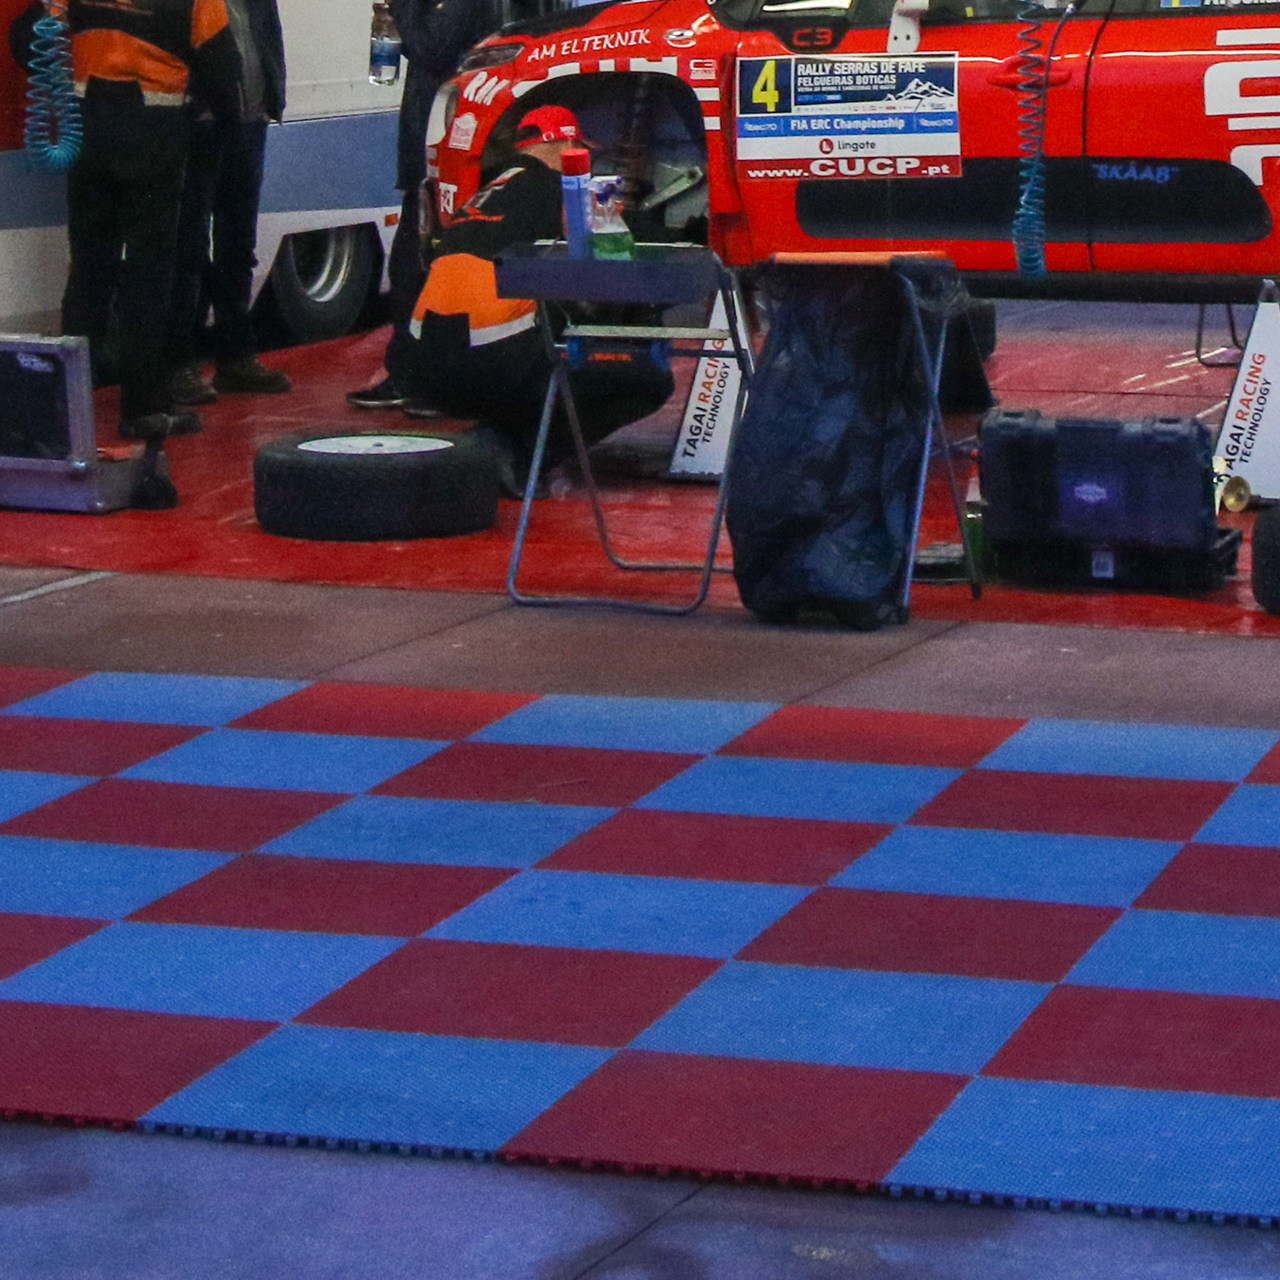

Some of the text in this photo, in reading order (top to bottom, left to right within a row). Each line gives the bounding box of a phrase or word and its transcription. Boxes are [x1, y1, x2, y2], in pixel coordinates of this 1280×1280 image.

[527, 28, 652, 62] AM ELTEKNIK
[792, 28, 833, 46] C3
[797, 60, 926, 76] RALLY SERRAS DE FAFE
[797, 74, 897, 86] FELGUEIRAS BOTICAS
[752, 59, 780, 113] 4
[790, 117, 906, 131] FIA ERC Championship
[747, 158, 950, 178] www.CUCP.pt
[701, 361, 731, 445] TECHNOLOGY
[1237, 352, 1267, 423] RACING
[682, 404, 708, 460] TAGAI
[1239, 377, 1272, 465] TECHNOLOGY
